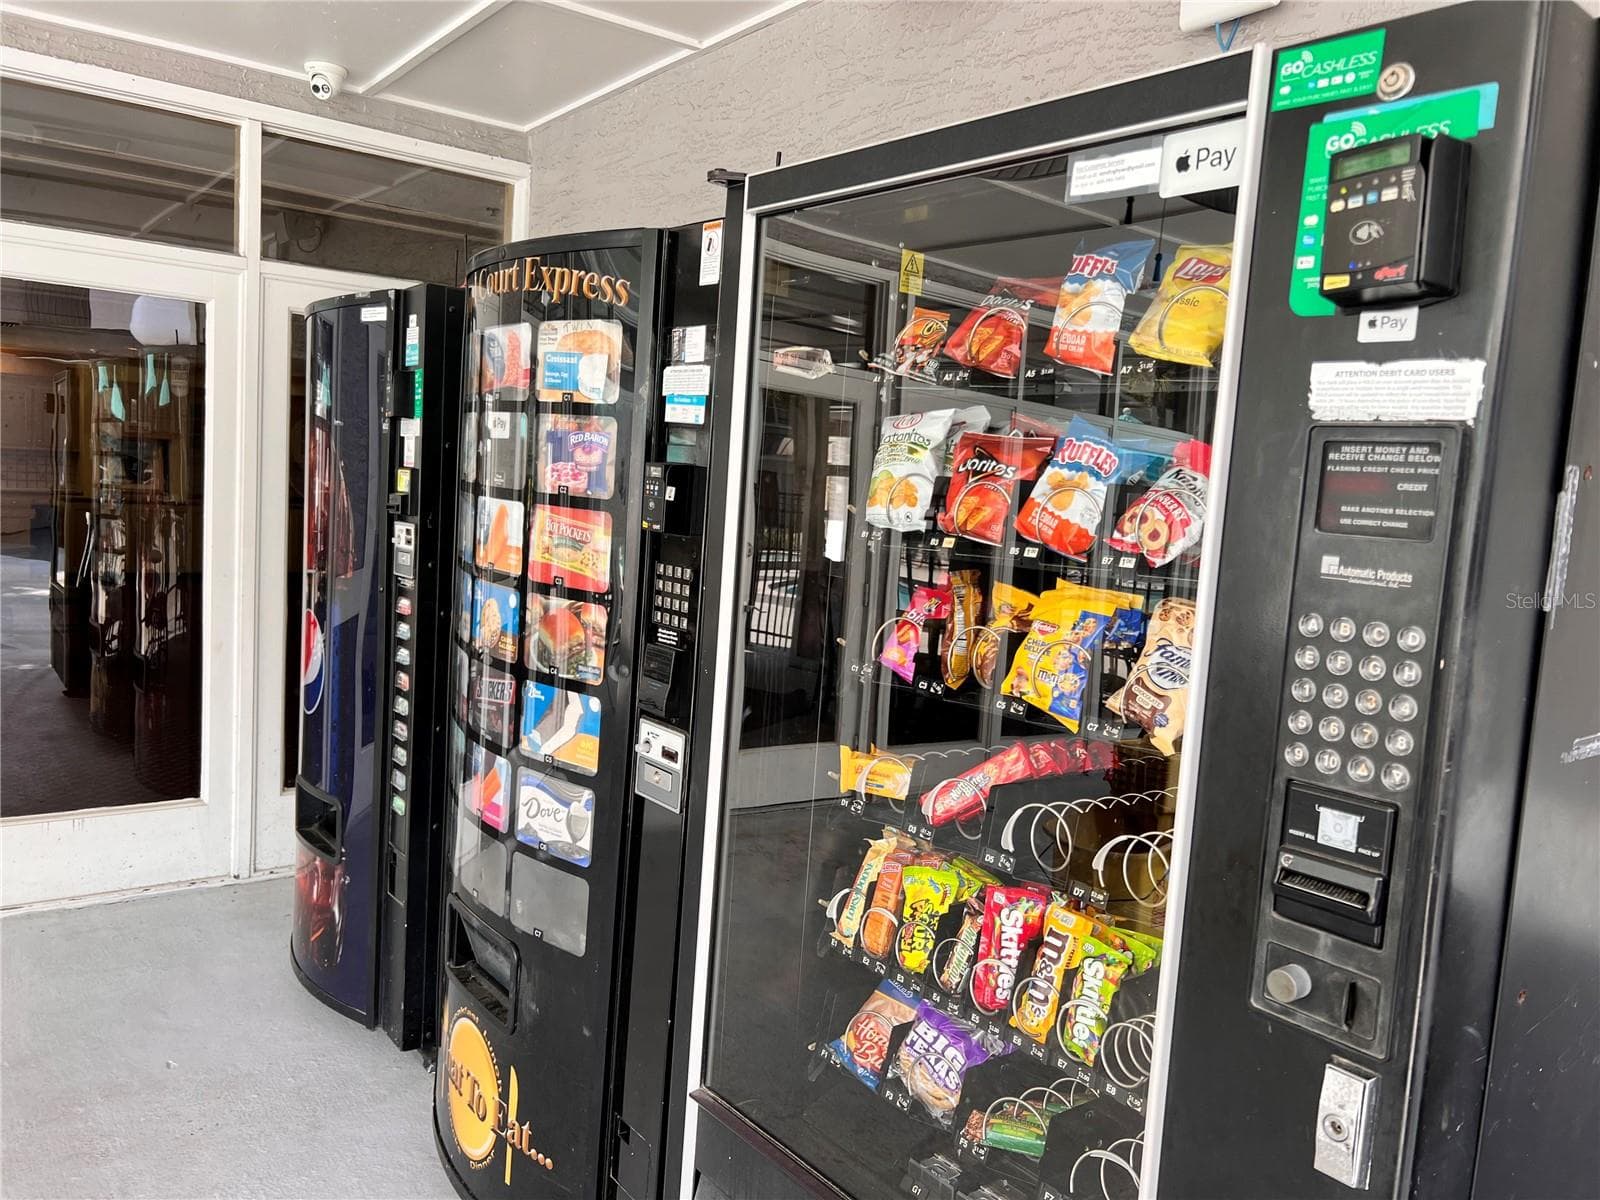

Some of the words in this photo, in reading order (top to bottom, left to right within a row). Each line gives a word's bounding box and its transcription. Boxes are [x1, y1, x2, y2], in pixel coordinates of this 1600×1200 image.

[1281, 61, 1304, 76] GO
[1301, 51, 1378, 78] CASHLESS
[1326, 133, 1355, 150] GO
[1196, 147, 1237, 171] Pay
[523, 257, 631, 306] Express
[979, 294, 1034, 310] Doritos
[1381, 316, 1408, 331] Pay
[1025, 370, 1036, 378] A5
[1120, 366, 1132, 375] A7
[1335, 370, 1377, 378] ATTENTION
[570, 433, 584, 445] RED
[584, 432, 608, 446] BARON
[1341, 446, 1372, 454] INSERT
[1375, 446, 1406, 454] MONEY
[1409, 446, 1429, 454] AND
[1054, 437, 1119, 477] RUFFLES
[1368, 454, 1405, 462] CHANGE
[958, 458, 1017, 478] Doritos
[1397, 483, 1428, 491] CREDIT
[1338, 565, 1376, 579] Automatic
[1377, 569, 1413, 583] Products
[1309, 620, 1318, 630] A
[1340, 623, 1350, 634] B
[1374, 628, 1384, 639] C
[1408, 633, 1419, 644] D
[1305, 653, 1314, 663] E
[1337, 656, 1346, 667] F
[1370, 662, 1380, 673] G
[1404, 667, 1415, 679] H
[1303, 685, 1310, 696] 1
[1334, 690, 1342, 701] 2
[996, 700, 1006, 709] C5
[1367, 696, 1376, 707] 3
[1401, 703, 1410, 714] 4
[1087, 723, 1099, 733] C7
[1299, 717, 1307, 728] 5
[1330, 723, 1338, 734] 6
[1364, 728, 1372, 740] 7
[1398, 736, 1407, 748] 8
[1295, 749, 1303, 760] 9
[1323, 755, 1337, 767] 10
[522, 797, 563, 823] Dove
[908, 825, 917, 834] D3
[985, 854, 994, 863] D5
[1073, 887, 1084, 897] D7
[995, 908, 1025, 1001] Skittles
[971, 1013, 980, 1024] E5
[916, 1020, 965, 1068] BIG
[1013, 1036, 1023, 1046] E6
[905, 1031, 961, 1090] TEXAS
[1057, 1059, 1068, 1069] E7
[885, 1090, 894, 1100] F3
[1106, 1083, 1117, 1096] E8
[465, 1071, 488, 1122] To
[959, 1137, 968, 1148] F5
[469, 1150, 496, 1170] Dinner
[911, 1184, 922, 1196] G1
